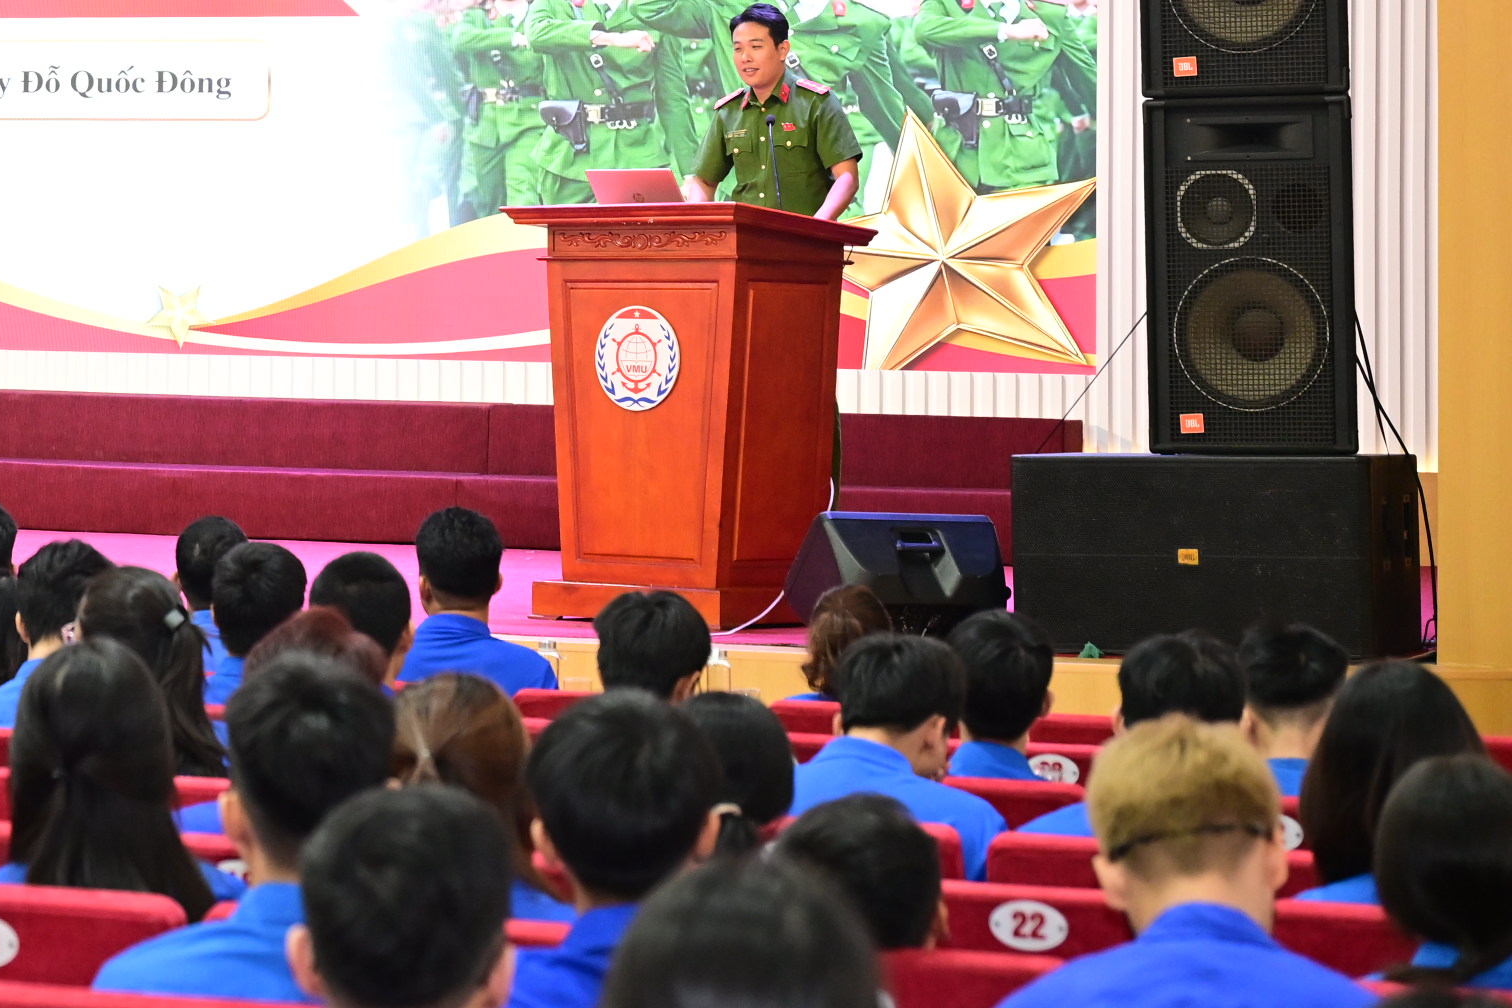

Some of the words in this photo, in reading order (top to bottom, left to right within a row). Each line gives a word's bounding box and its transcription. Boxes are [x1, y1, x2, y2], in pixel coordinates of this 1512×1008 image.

[1178, 61, 1193, 72] JBL
[20, 65, 61, 94] Đỗ
[70, 65, 146, 99] Quốc
[154, 69, 232, 100] Đông
[625, 364, 648, 374] VMU
[1012, 911, 1047, 940] 22
